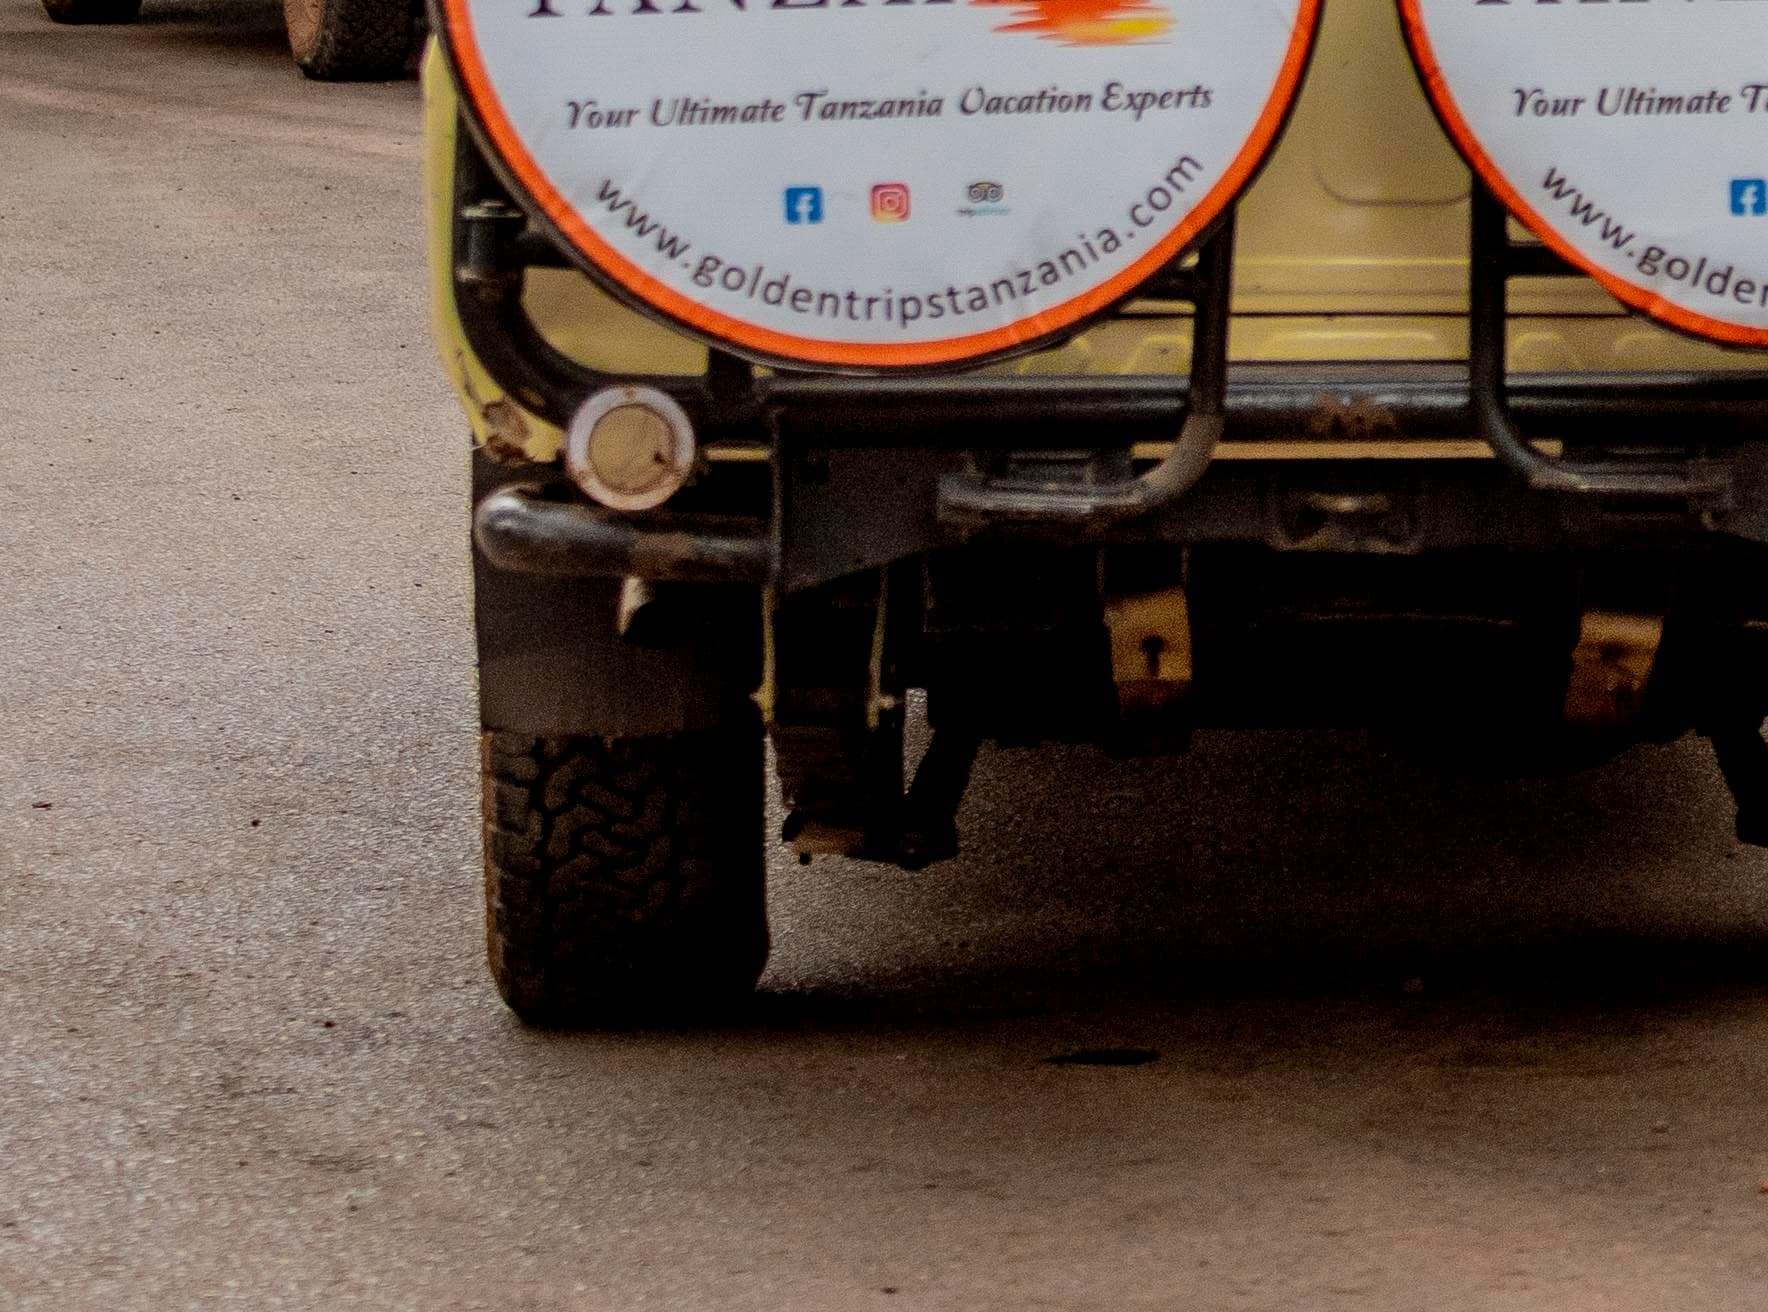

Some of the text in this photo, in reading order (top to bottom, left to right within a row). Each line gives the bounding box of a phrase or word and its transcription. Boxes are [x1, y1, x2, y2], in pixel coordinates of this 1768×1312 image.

[566, 81, 1214, 130] Your Ultimate Tanzania Vacation Experts
[1513, 87, 1586, 118] Your
[1597, 86, 1733, 117] Ultimate
[595, 152, 1204, 329] www.goldentripstanzania.com
